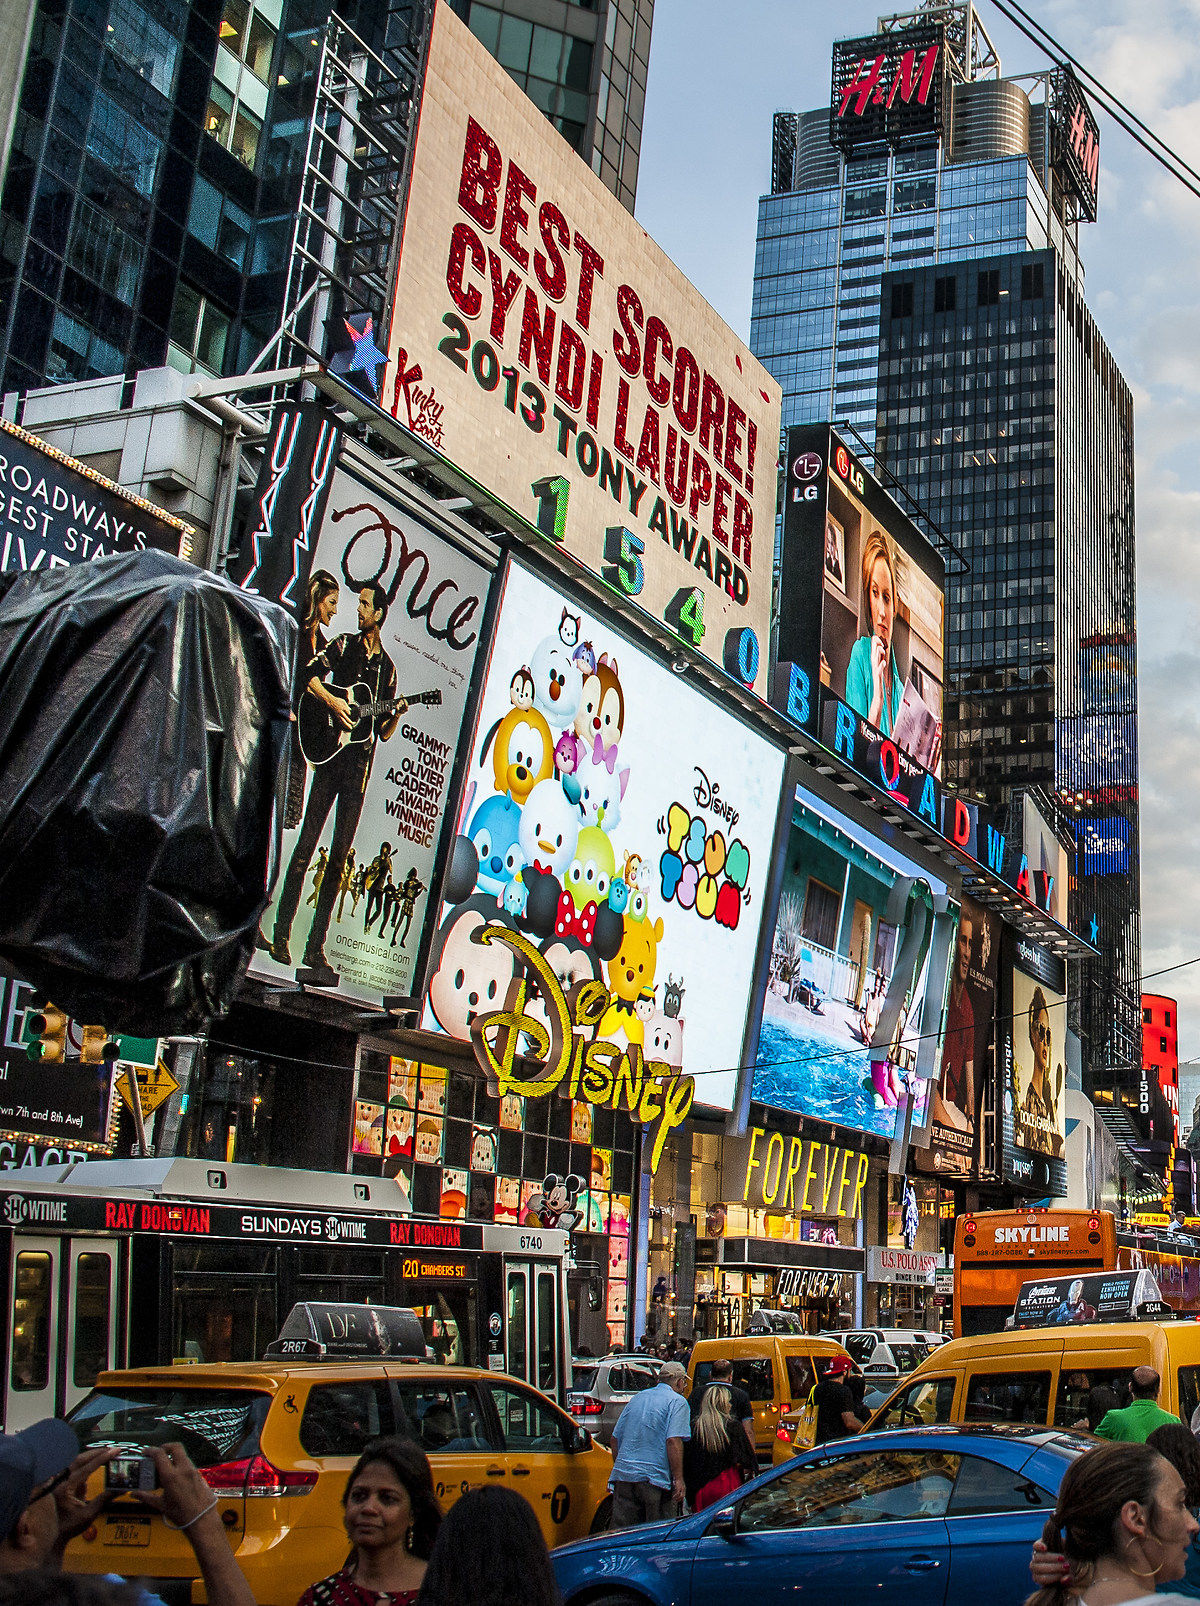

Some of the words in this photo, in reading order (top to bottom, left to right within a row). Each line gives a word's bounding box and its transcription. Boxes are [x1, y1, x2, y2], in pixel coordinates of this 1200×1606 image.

[837, 45, 940, 117] H&M
[457, 114, 605, 335] BEST
[611, 284, 758, 497] SCORE!
[446, 222, 604, 434] CYNDI
[613, 376, 754, 571] LAUPER
[411, 414, 447, 452] Boots
[437, 312, 547, 433] 2013
[552, 404, 648, 518] TONY
[647, 500, 750, 607] AWARD
[793, 485, 819, 503] LG
[850, 464, 865, 495] LG
[64, 527, 120, 562] STA
[331, 503, 480, 650] Once
[401, 723, 452, 759] GRAMMY
[401, 757, 445, 790] OLIVIER
[417, 746, 449, 774] TONY
[385, 767, 443, 804] ACADEMY
[693, 766, 740, 835] Disney
[385, 798, 436, 834] WINNING
[397, 821, 434, 849] MUSIC
[336, 934, 411, 965] oncemusical.com
[137, 1086, 158, 1095] HARE
[16, 1105, 30, 1118] 7th
[31, 1108, 49, 1121] and
[50, 1109, 64, 1123] 8th
[742, 1126, 870, 1219] FOREVER
[4, 1193, 68, 1224] SHOWTIME
[105, 1201, 137, 1229] RAY
[141, 1204, 211, 1234] DONOVAN
[241, 1215, 322, 1236] SUNDAYS
[324, 1216, 367, 1240] SHOWTIME
[390, 1222, 412, 1244] RAY
[413, 1224, 461, 1247] DONOVAN
[994, 1226, 1070, 1244] SKYLINE
[520, 1236, 543, 1250] 6740
[420, 1264, 455, 1277] CHAMBERS
[455, 1264, 466, 1278] ST
[881, 1250, 896, 1268] U.S.
[896, 1251, 918, 1271] POLO
[776, 1269, 829, 1298] FOREVER
[895, 1273, 913, 1283] SINCE
[1020, 1295, 1061, 1307] STATION
[1146, 1303, 1162, 1312] 2G44
[281, 1341, 306, 1353] 2R67
